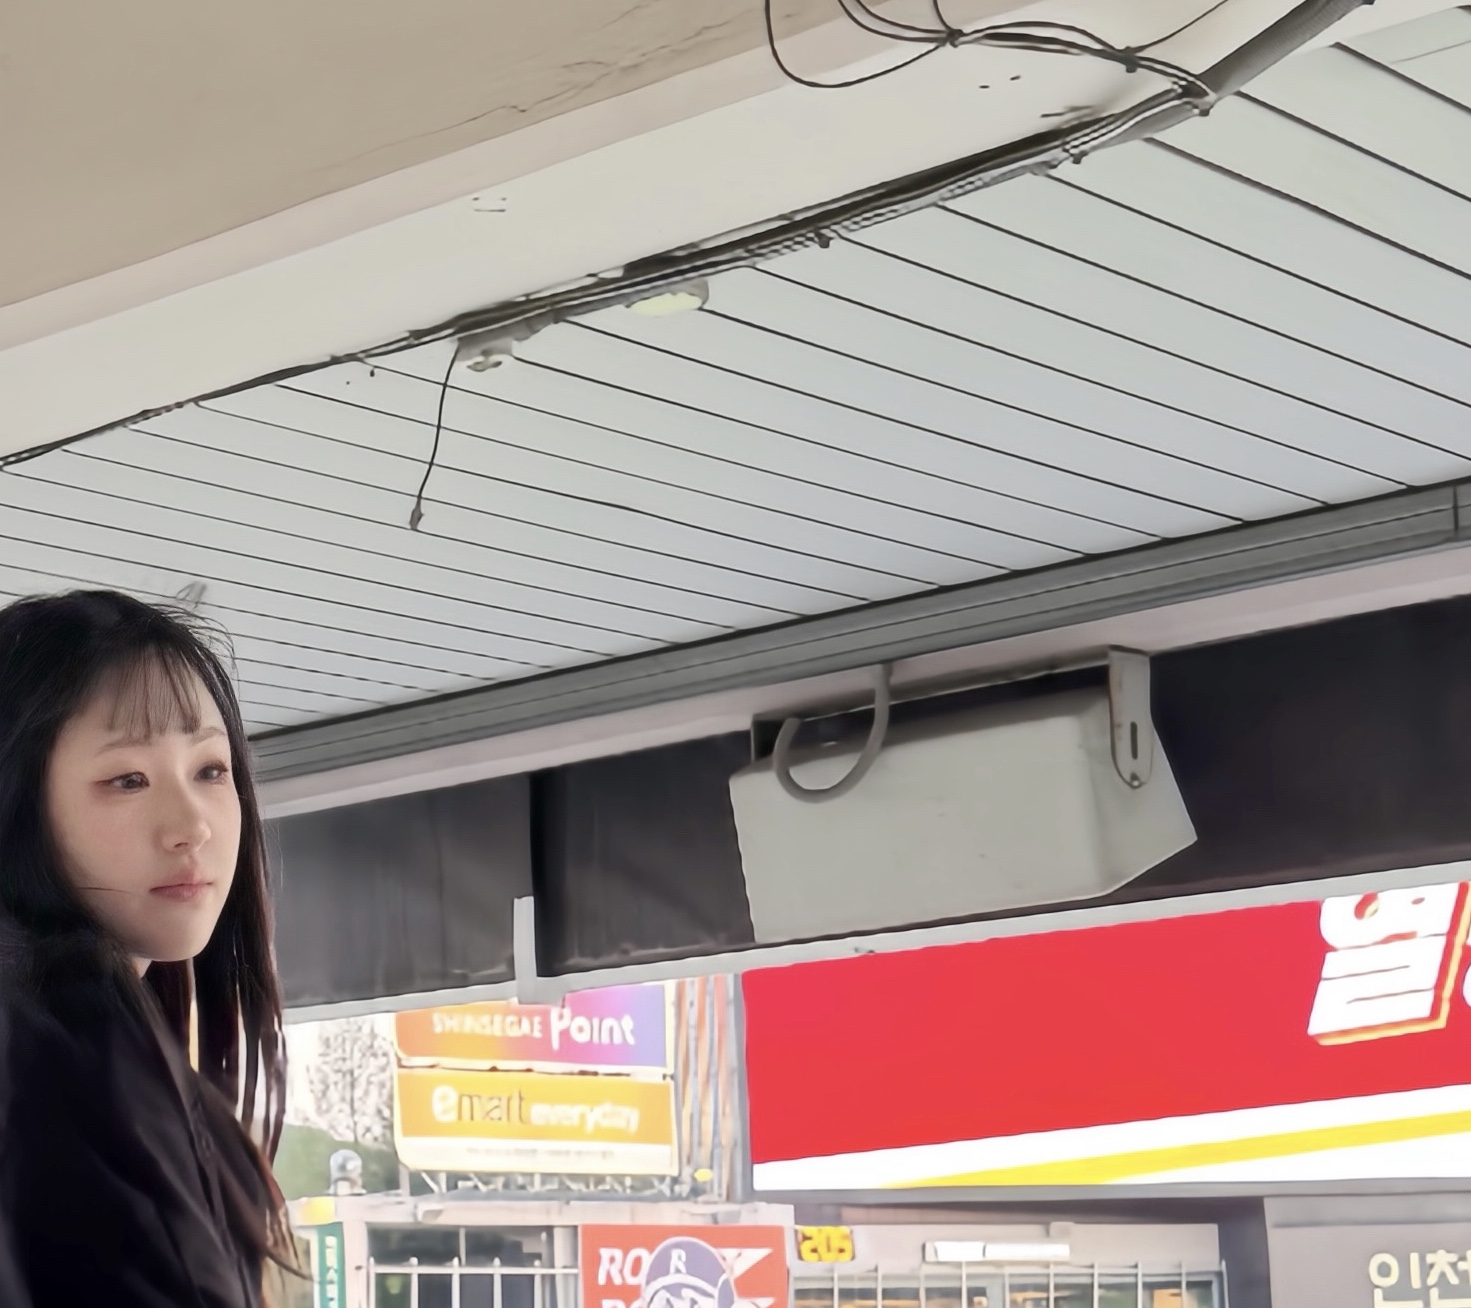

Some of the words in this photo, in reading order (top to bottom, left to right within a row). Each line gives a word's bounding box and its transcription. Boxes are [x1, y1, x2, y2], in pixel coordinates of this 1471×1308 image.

[432, 1012, 542, 1038] SHINSEGAE
[550, 1006, 636, 1051] Point
[431, 1085, 527, 1124] emart
[529, 1101, 640, 1135] everyday
